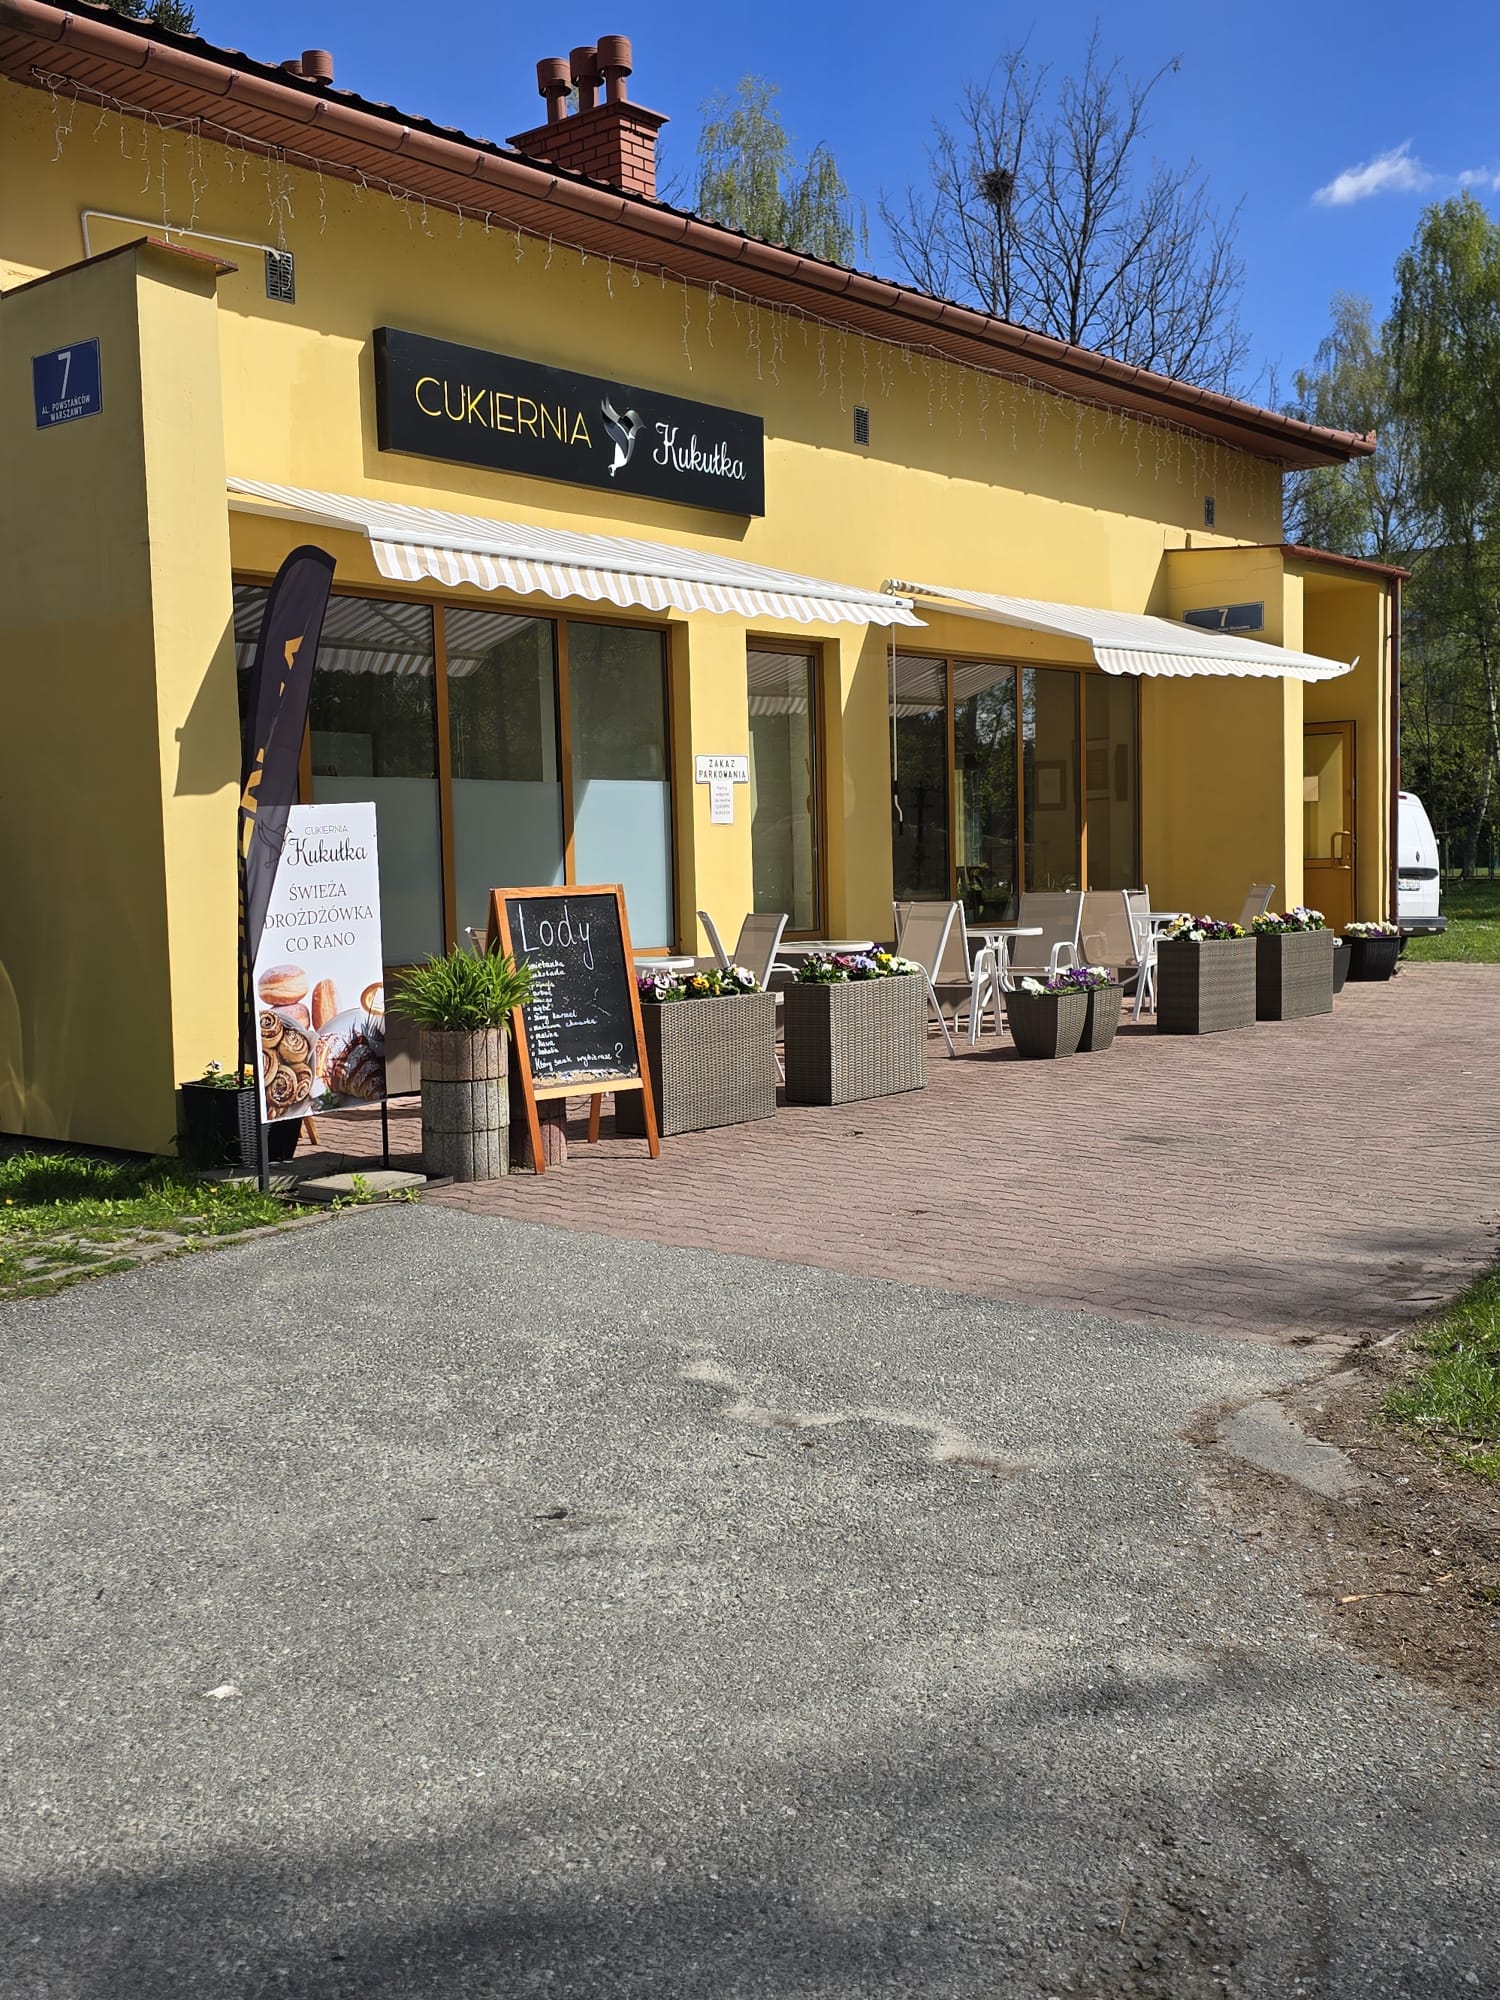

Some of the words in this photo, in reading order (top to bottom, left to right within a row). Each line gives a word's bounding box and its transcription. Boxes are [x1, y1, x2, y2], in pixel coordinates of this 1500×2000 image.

[57, 350, 71, 400] 7
[52, 393, 91, 412] POWSTAŃCÓW
[415, 376, 592, 449] CUKIERNIA
[51, 406, 82, 421] WARSZAWY
[1218, 608, 1229, 627] 7
[708, 759, 736, 768] ZAKAZ
[698, 769, 746, 779] PARKOWANIA
[304, 825, 349, 835] CUKIERNIA
[289, 880, 347, 901] ŚWIEŻA
[264, 905, 374, 929] DROŻDŻÓWKA
[285, 937, 309, 953] CO
[313, 931, 356, 950] RANO
[518, 903, 595, 971] Lody
